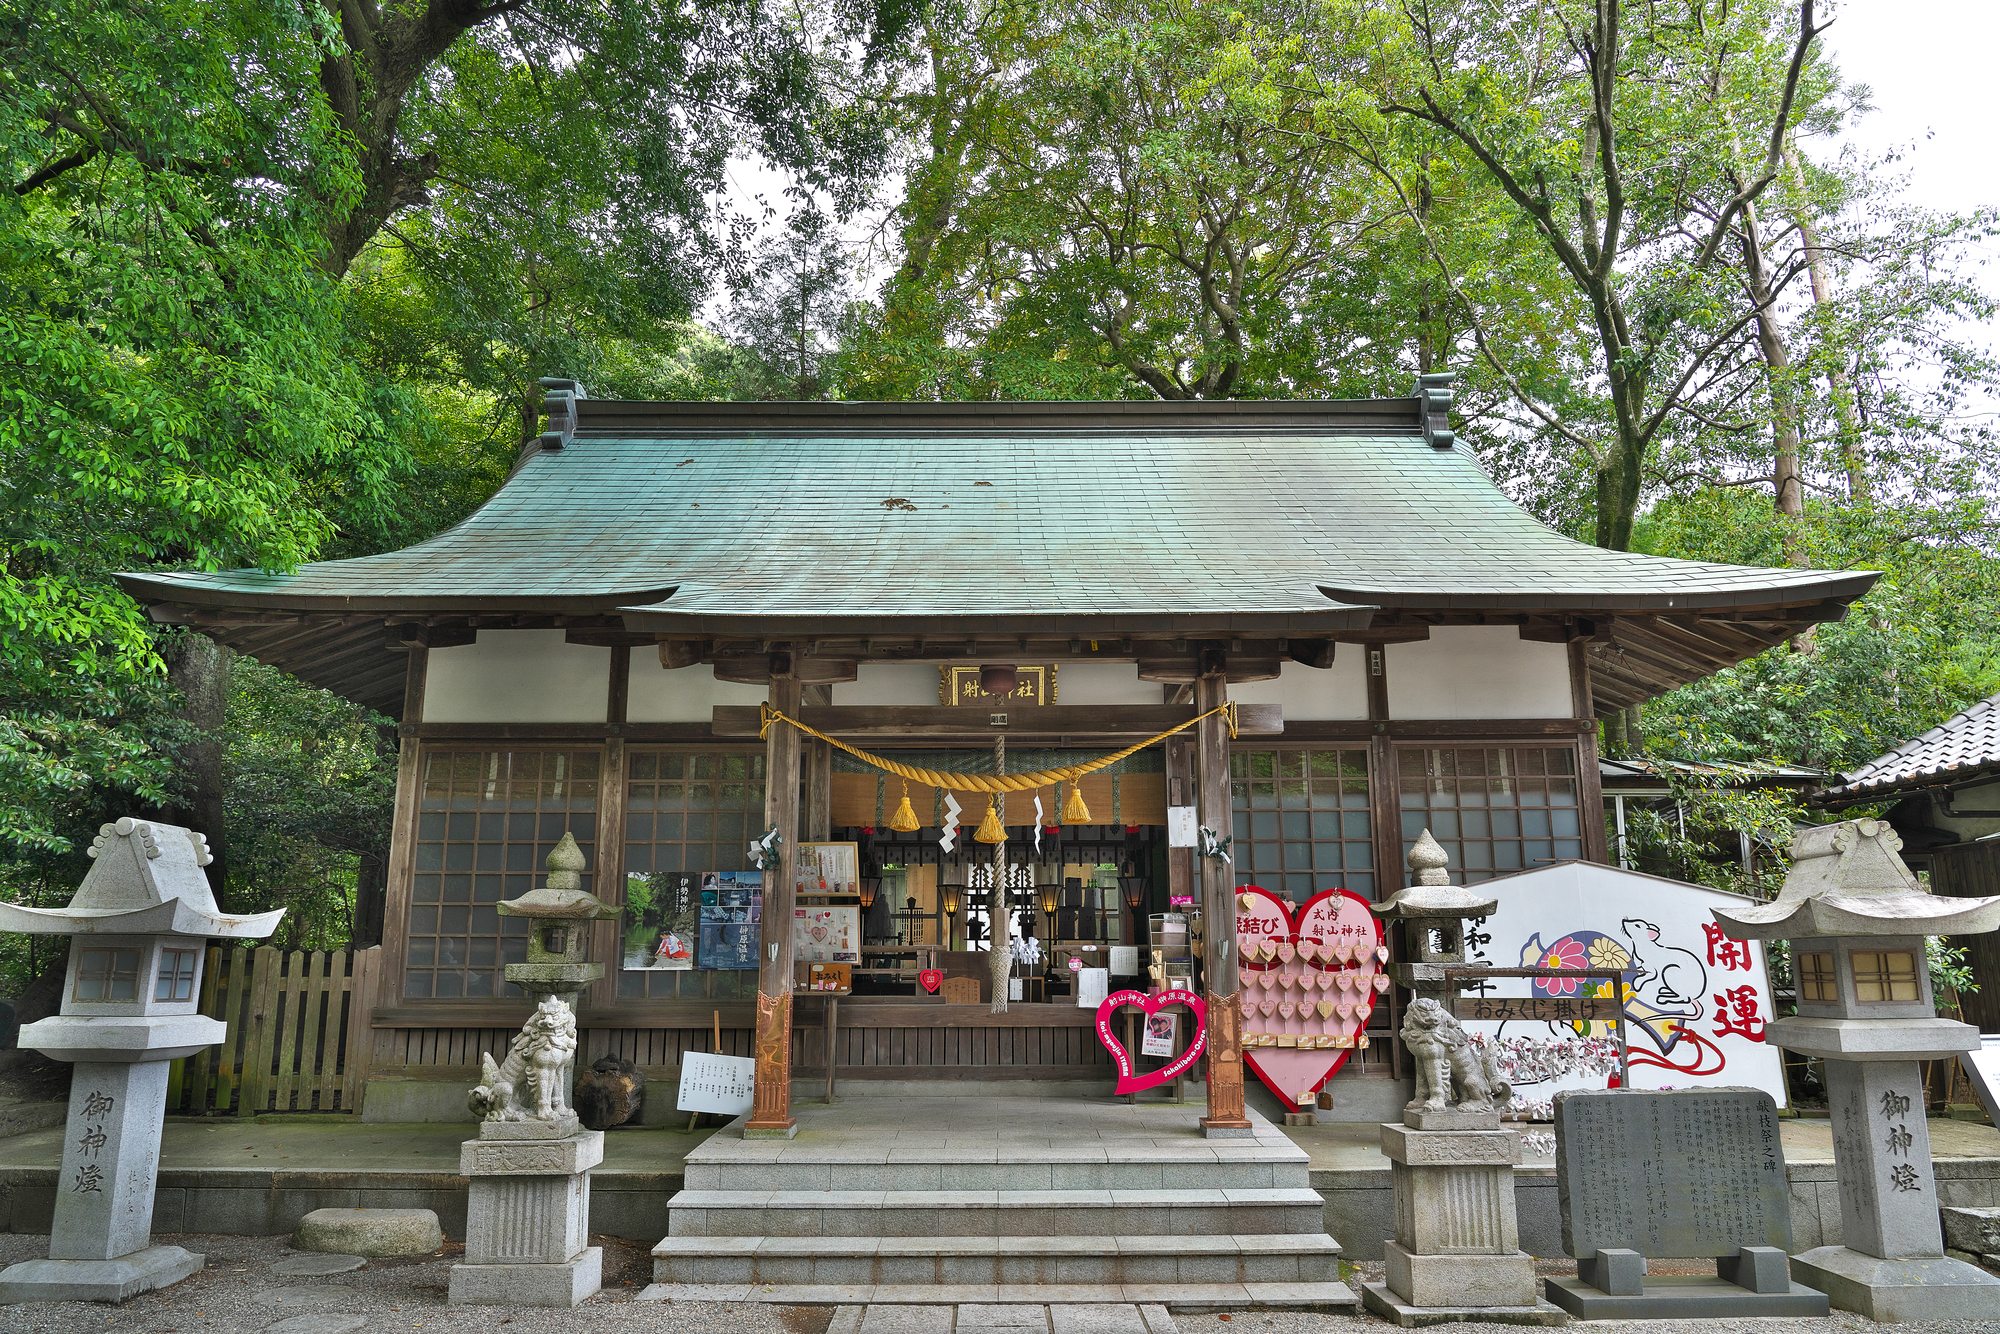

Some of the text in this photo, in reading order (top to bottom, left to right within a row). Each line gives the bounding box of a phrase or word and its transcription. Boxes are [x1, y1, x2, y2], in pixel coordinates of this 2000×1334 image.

[962, 680, 1035, 699] 射社
[680, 878, 689, 913] 伊勢神宮
[1313, 908, 1338, 921] 式内
[1312, 924, 1367, 937] 射山神社
[739, 925, 749, 963] 榊原温泉
[815, 970, 843, 982] おみくじ
[1701, 922, 1767, 1042] 開運
[1108, 993, 1146, 1007] 射山神社
[1158, 992, 1196, 1006] 榊原温泉
[1474, 1000, 1600, 1020] おみくじ掛け
[72, 1090, 114, 1194] 御神燈
[1756, 1100, 1777, 1174] 献枝祭之碑
[1879, 1089, 1921, 1193] 御神燈
